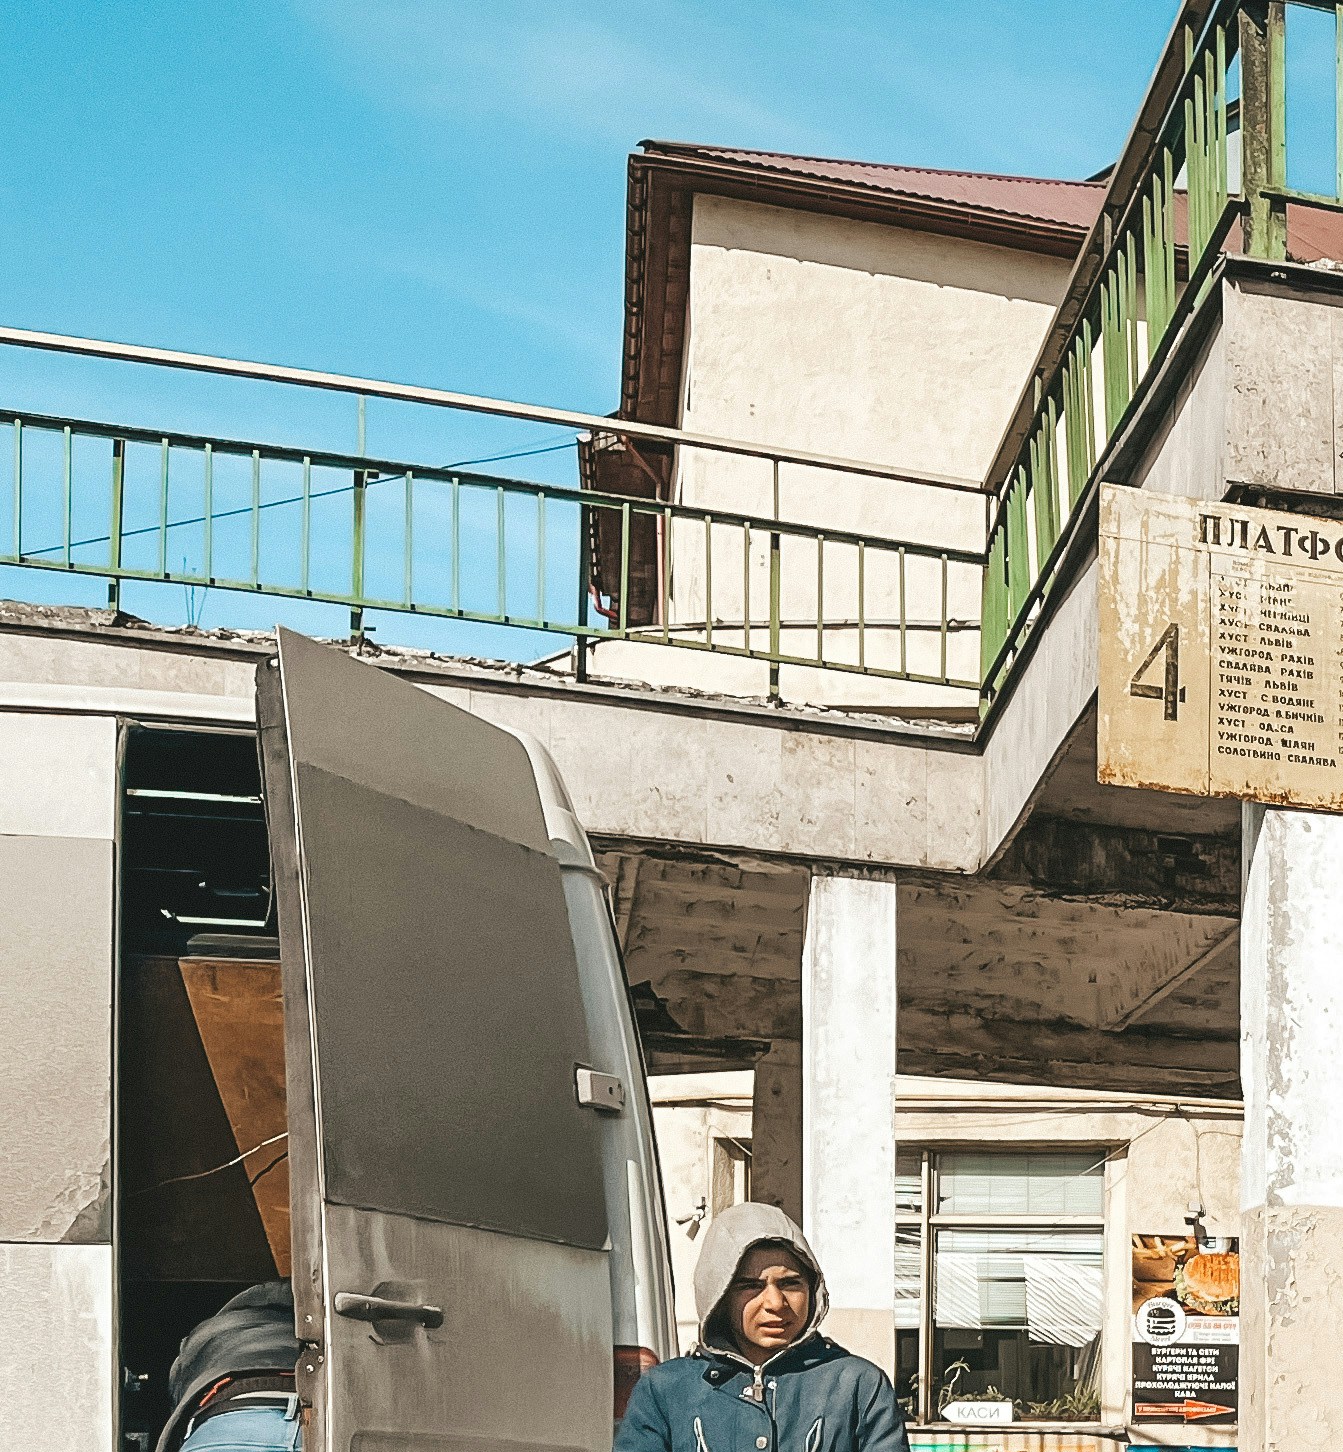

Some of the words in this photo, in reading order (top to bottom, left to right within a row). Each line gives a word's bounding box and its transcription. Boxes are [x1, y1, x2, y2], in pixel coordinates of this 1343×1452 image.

[1259, 623, 1310, 637] СВАЛЯВА
[1219, 632, 1248, 642] ХУСТ
[1260, 637, 1292, 648] ЛЬВІВ
[1219, 646, 1273, 661] УЖГОРОД
[1281, 654, 1314, 665] РАХІВ
[1130, 623, 1186, 721] 4
[1219, 660, 1271, 674] СВАЛЯВА
[1281, 668, 1313, 679] РАХІВ
[1219, 674, 1252, 685] ТЯЧІВ
[1265, 680, 1298, 691] ЛЬВІВ
[1219, 689, 1247, 699] ХУСТ
[1218, 703, 1270, 717] УЖГОРОД
[1218, 717, 1245, 728] ХУСТ
[1259, 722, 1294, 733] ОДСА
[1218, 731, 1273, 746] УЖГОРОД
[1218, 746, 1280, 761] СОЛОТВИНО
[1288, 754, 1336, 768] СВАЛЯВА
[957, 1406, 1000, 1419] КАСИ
